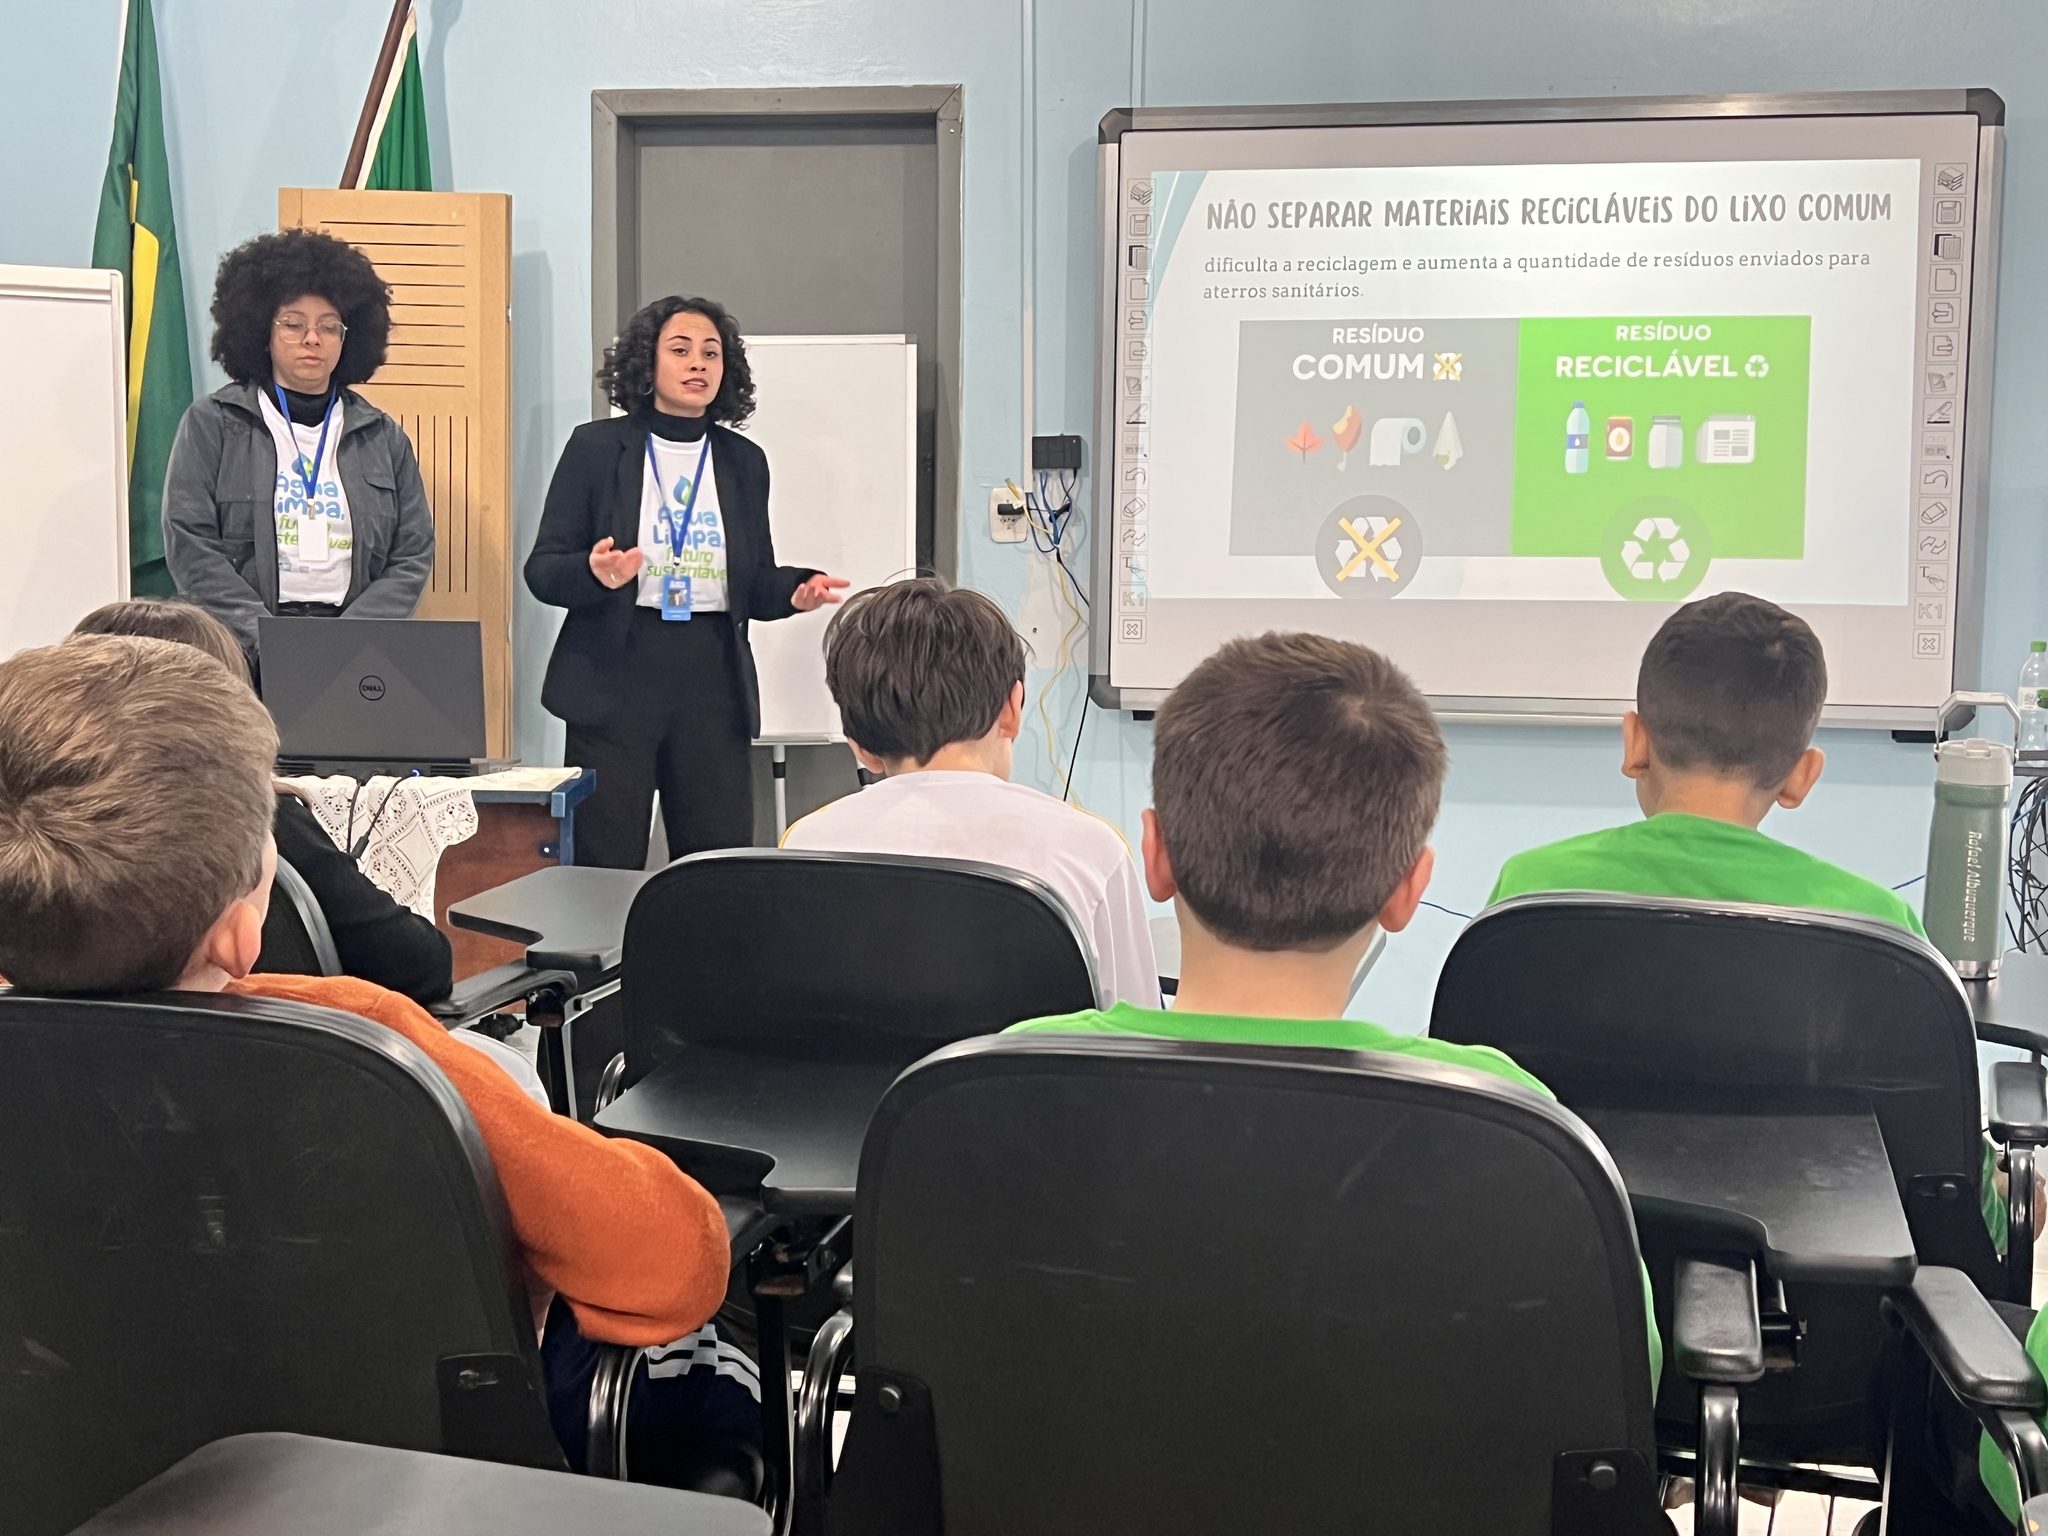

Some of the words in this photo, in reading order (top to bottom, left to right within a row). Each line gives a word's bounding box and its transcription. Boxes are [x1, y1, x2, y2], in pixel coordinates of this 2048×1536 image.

[1206, 199, 1257, 230] NÃO
[1267, 200, 1374, 229] SEPARAR
[1684, 194, 1719, 224] DO
[1797, 192, 1892, 222] COMUM
[1204, 256, 1279, 274] dificulta
[1282, 260, 1293, 273] a
[1296, 255, 1398, 276] reciclagem
[1402, 259, 1413, 272] e
[1416, 256, 1498, 271] aumenta
[1502, 257, 1513, 270] a
[1516, 252, 1621, 274] quantidade
[1626, 252, 1649, 268] de
[1652, 251, 1735, 268] resíduos
[1738, 250, 1824, 267] enviados
[1828, 252, 1871, 271] para
[1203, 284, 1268, 300] aterros
[1332, 323, 1425, 345] RESÍDUO
[1615, 319, 1712, 342] RESÍDUO
[1292, 352, 1425, 381] COMUM
[1555, 348, 1739, 379] RECICLÁVEL
[1965, 831, 1982, 869] Rafael
[1963, 868, 1981, 943] Albuquerque
